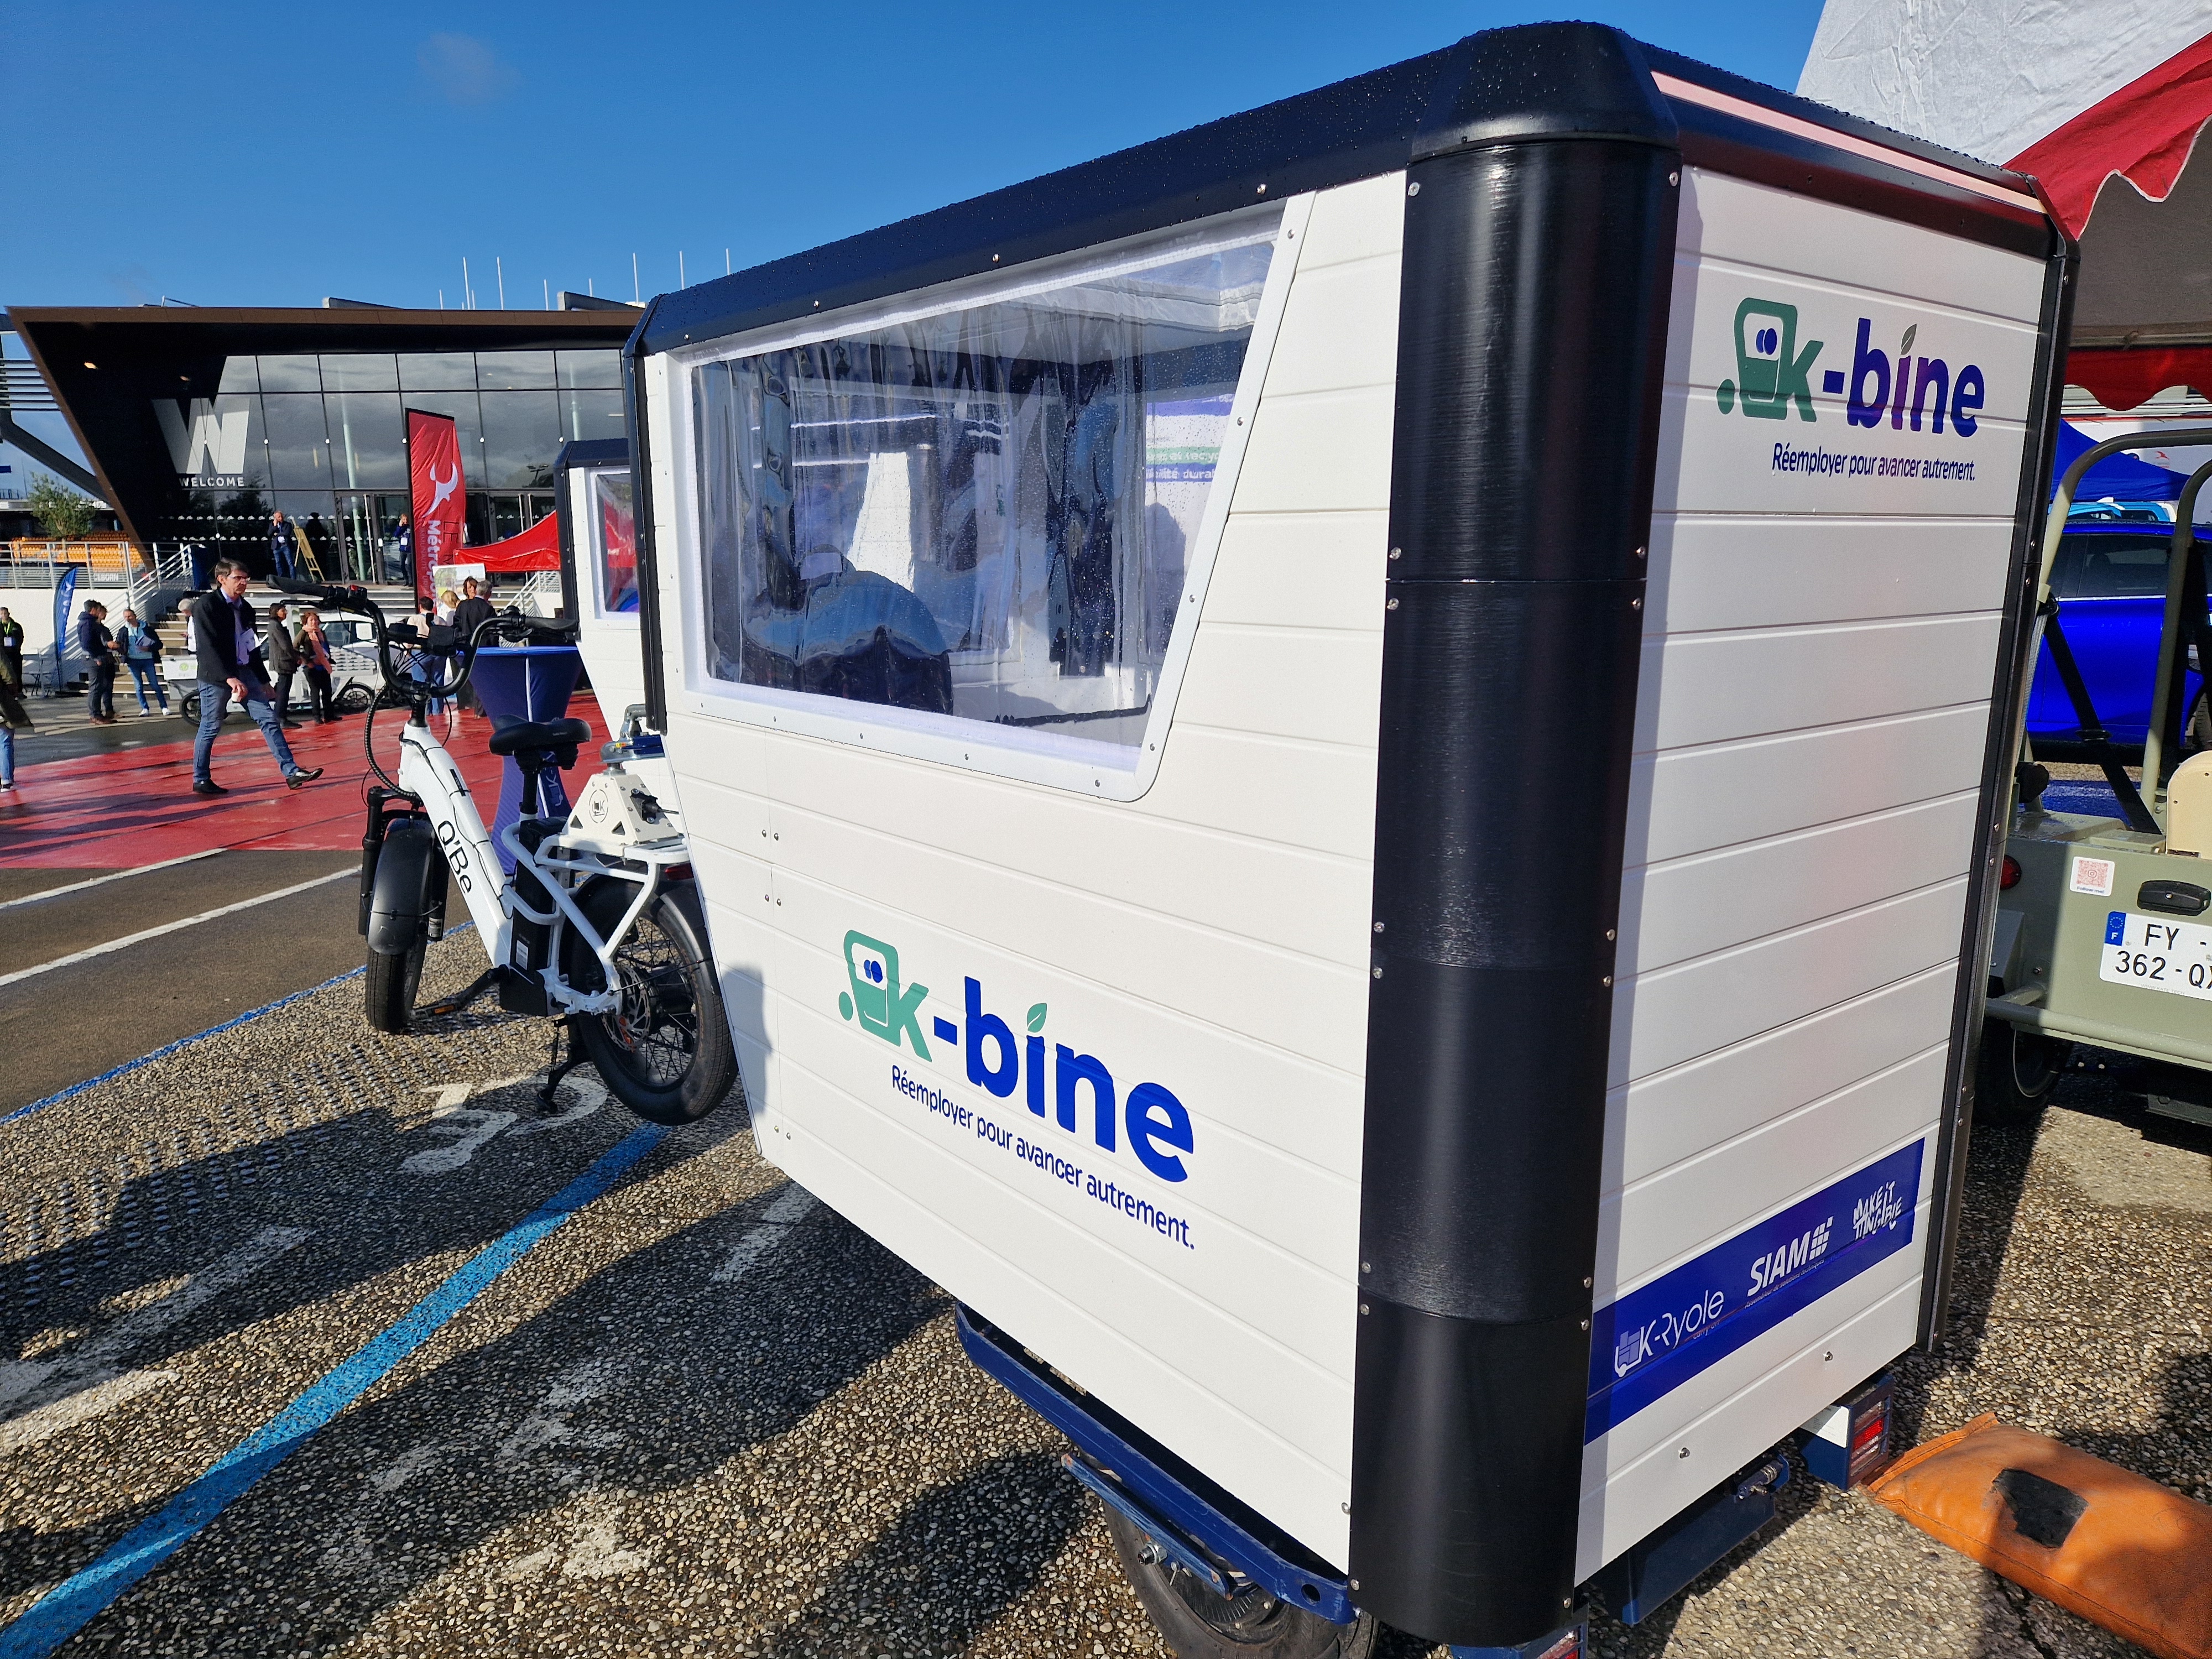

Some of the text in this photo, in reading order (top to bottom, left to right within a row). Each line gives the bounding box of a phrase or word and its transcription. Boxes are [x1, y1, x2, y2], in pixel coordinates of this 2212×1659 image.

[1772, 442, 1975, 481] Réemployer pour avancer autrement.
[179, 477, 245, 487] WELCOME
[444, 521, 459, 543] LE
[437, 820, 472, 894] Q'Be
[2144, 924, 2180, 951] FY
[891, 1065, 1194, 1250] Réemployer pour avancer autrement.
[1640, 1290, 1725, 1357] K-Ryole
